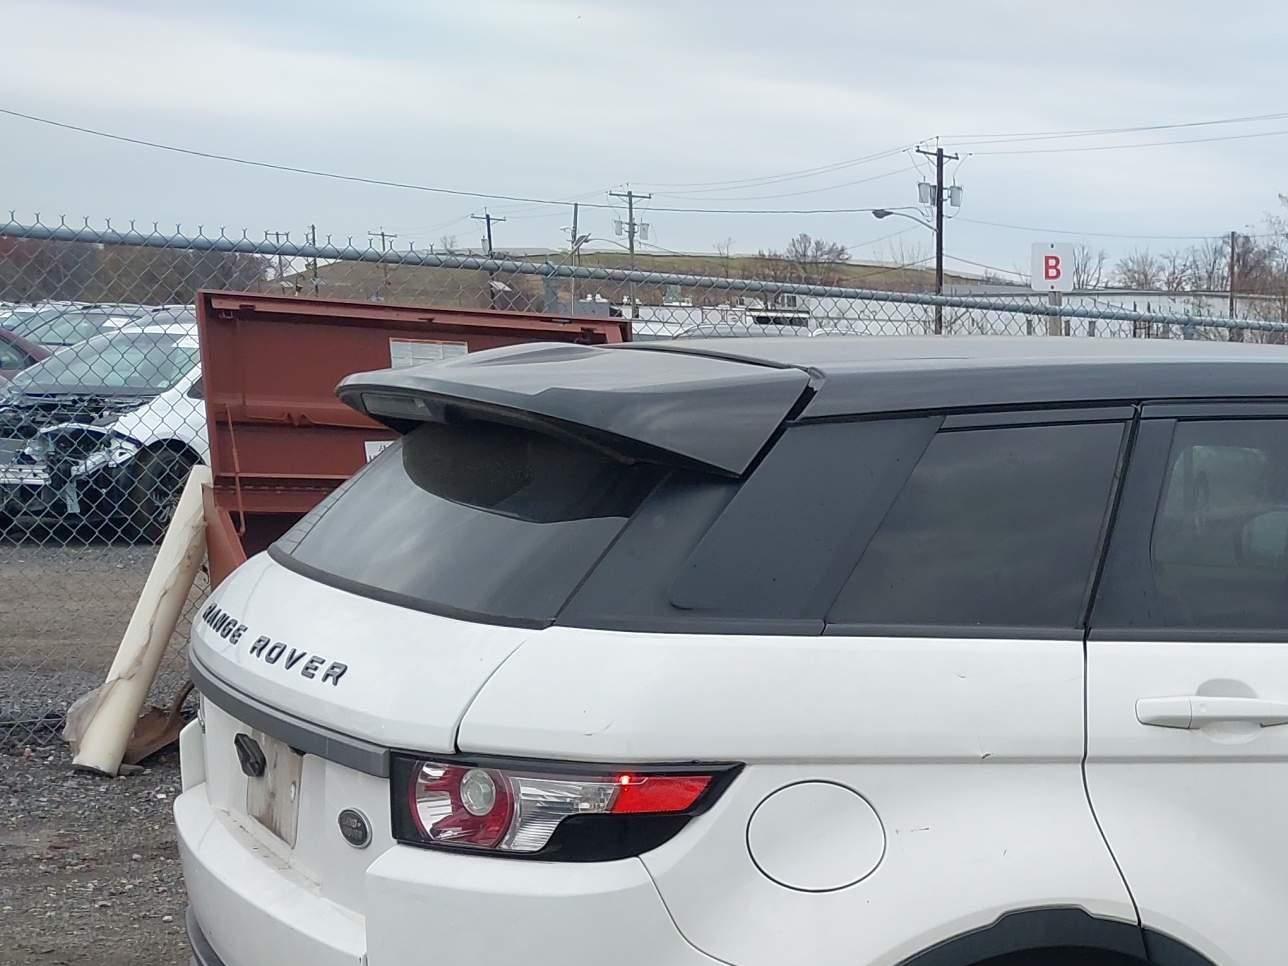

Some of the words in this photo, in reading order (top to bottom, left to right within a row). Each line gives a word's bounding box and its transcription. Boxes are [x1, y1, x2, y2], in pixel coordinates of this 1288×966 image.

[1044, 255, 1061, 281] B
[202, 602, 248, 645] RANGE
[249, 635, 348, 686] ROVER
